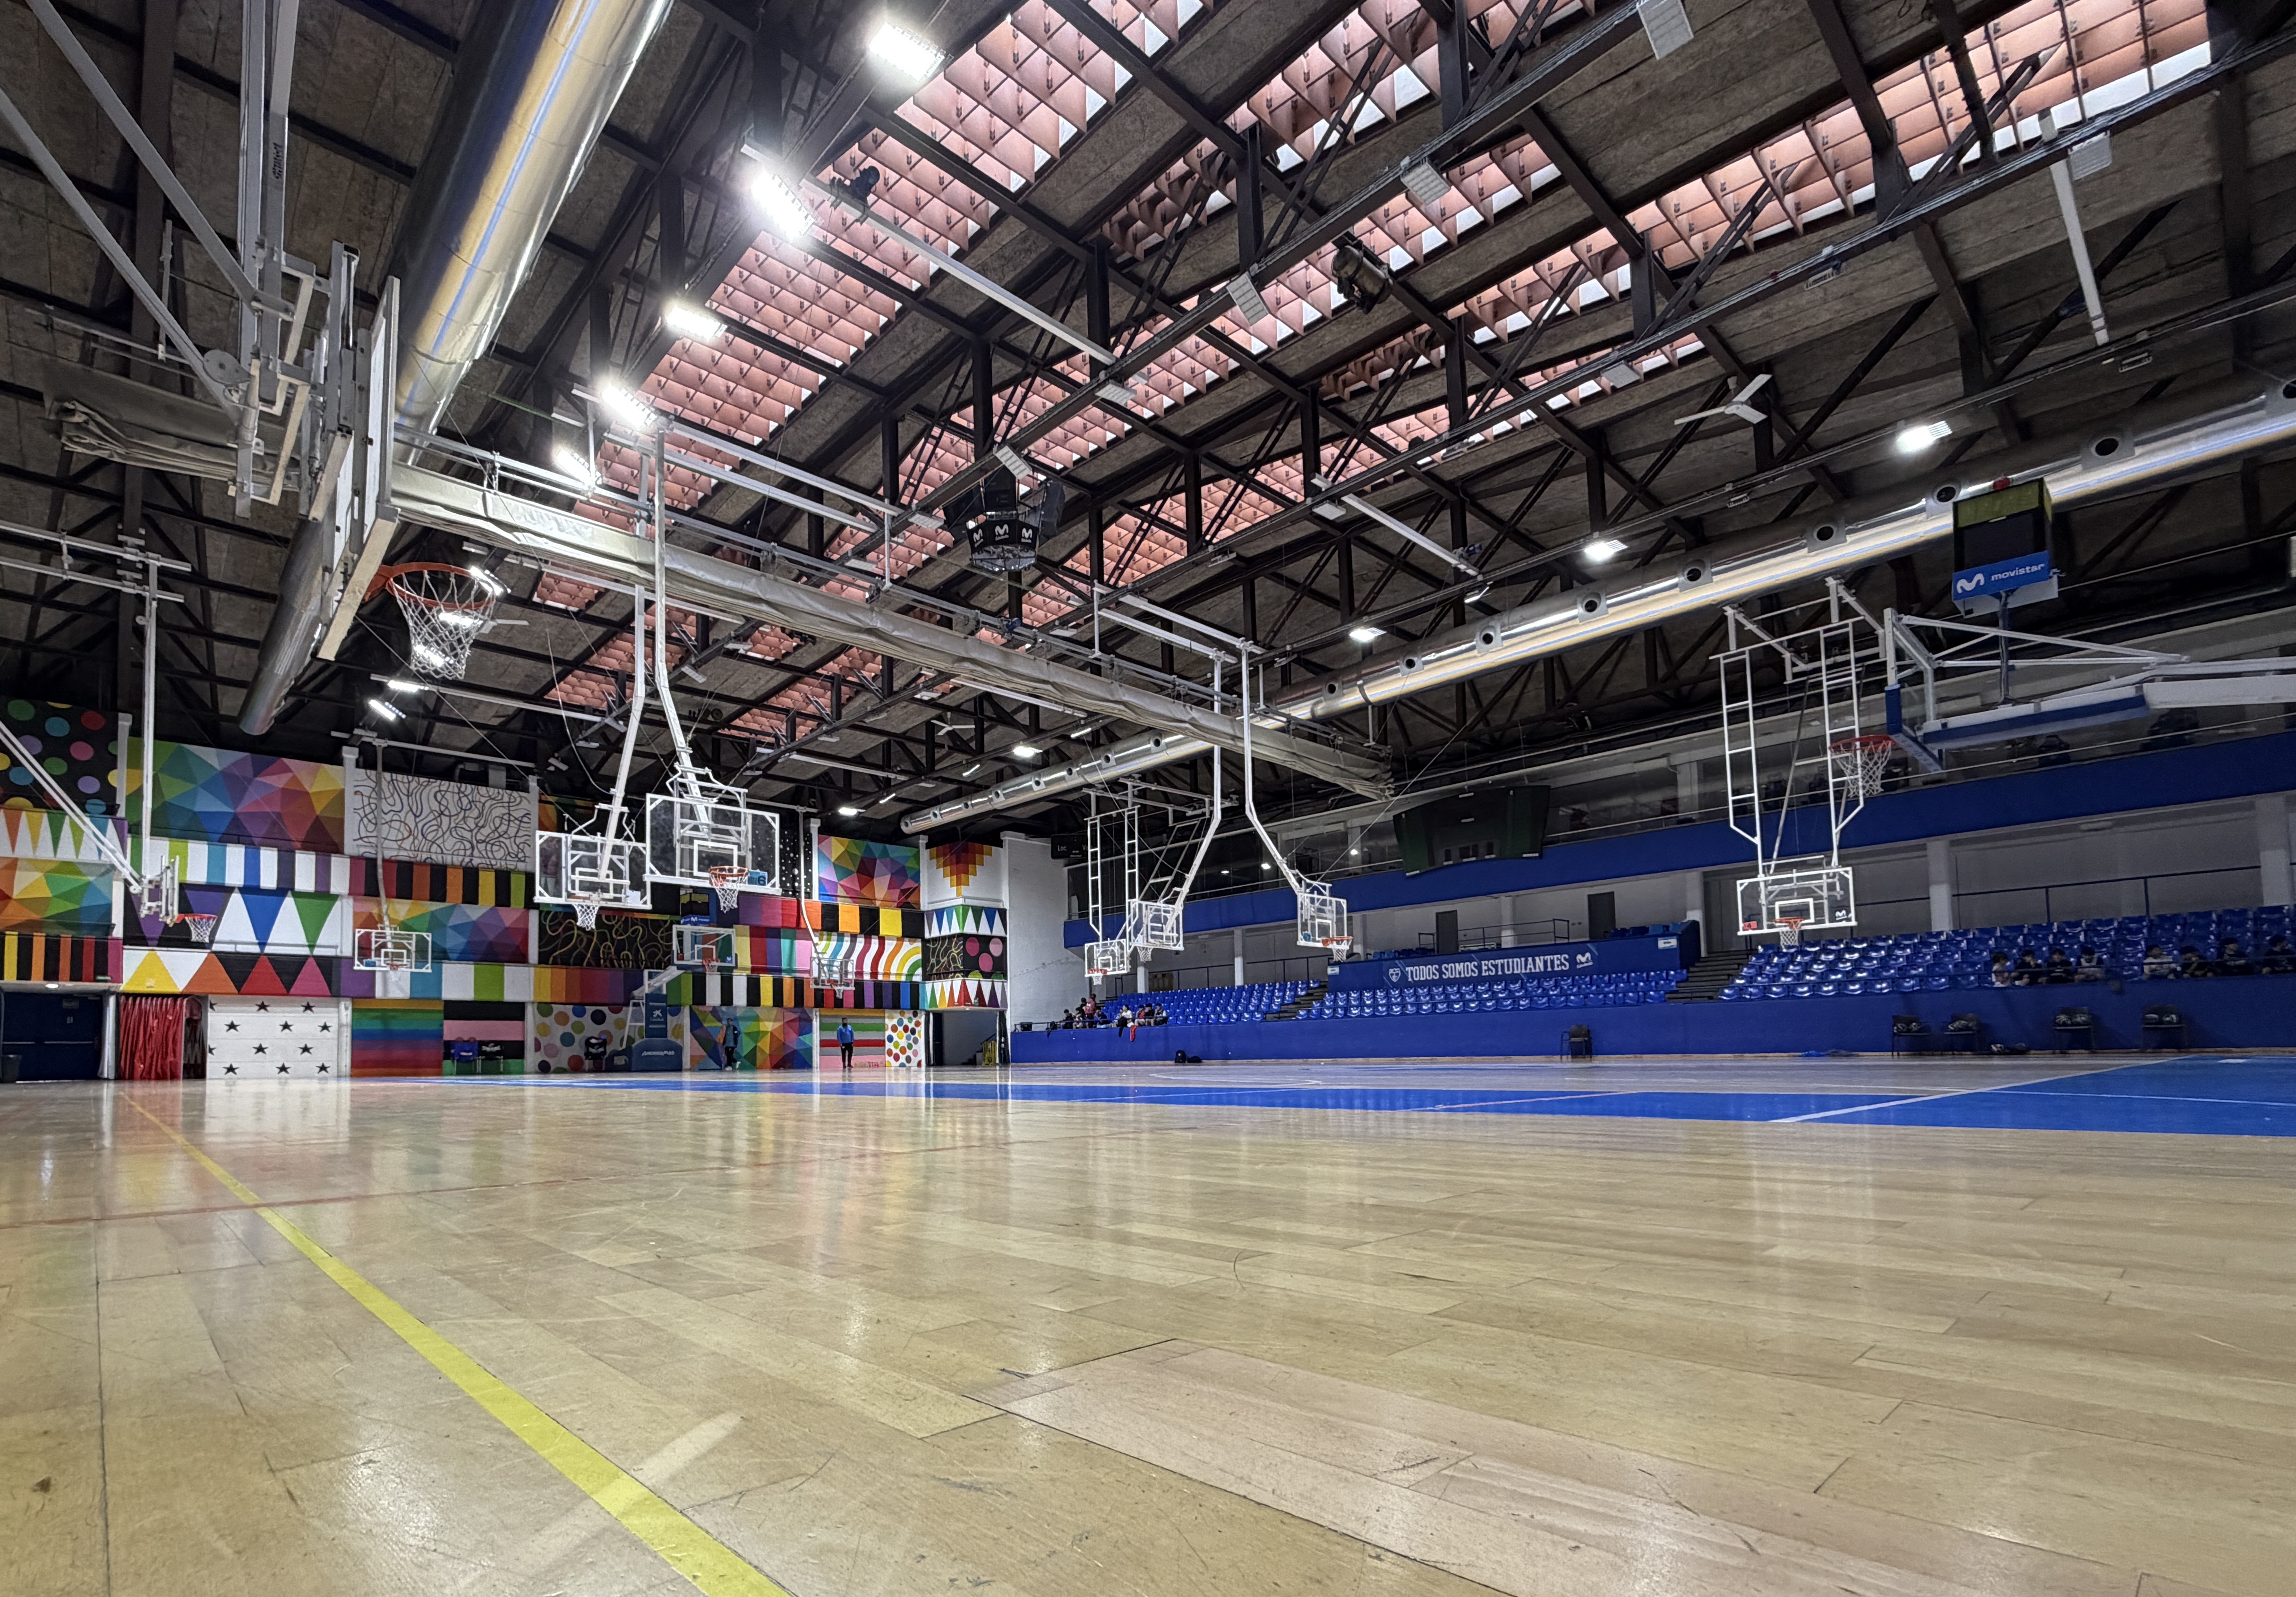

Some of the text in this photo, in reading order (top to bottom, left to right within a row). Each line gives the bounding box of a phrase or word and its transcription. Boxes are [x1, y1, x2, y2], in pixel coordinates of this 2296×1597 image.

[1990, 563, 2046, 581] movistar
[758, 875, 767, 886] 6
[1406, 965, 1439, 981] TODOS
[1442, 962, 1478, 979] SOMOS
[1481, 954, 1570, 976] ESTUDIANTES
